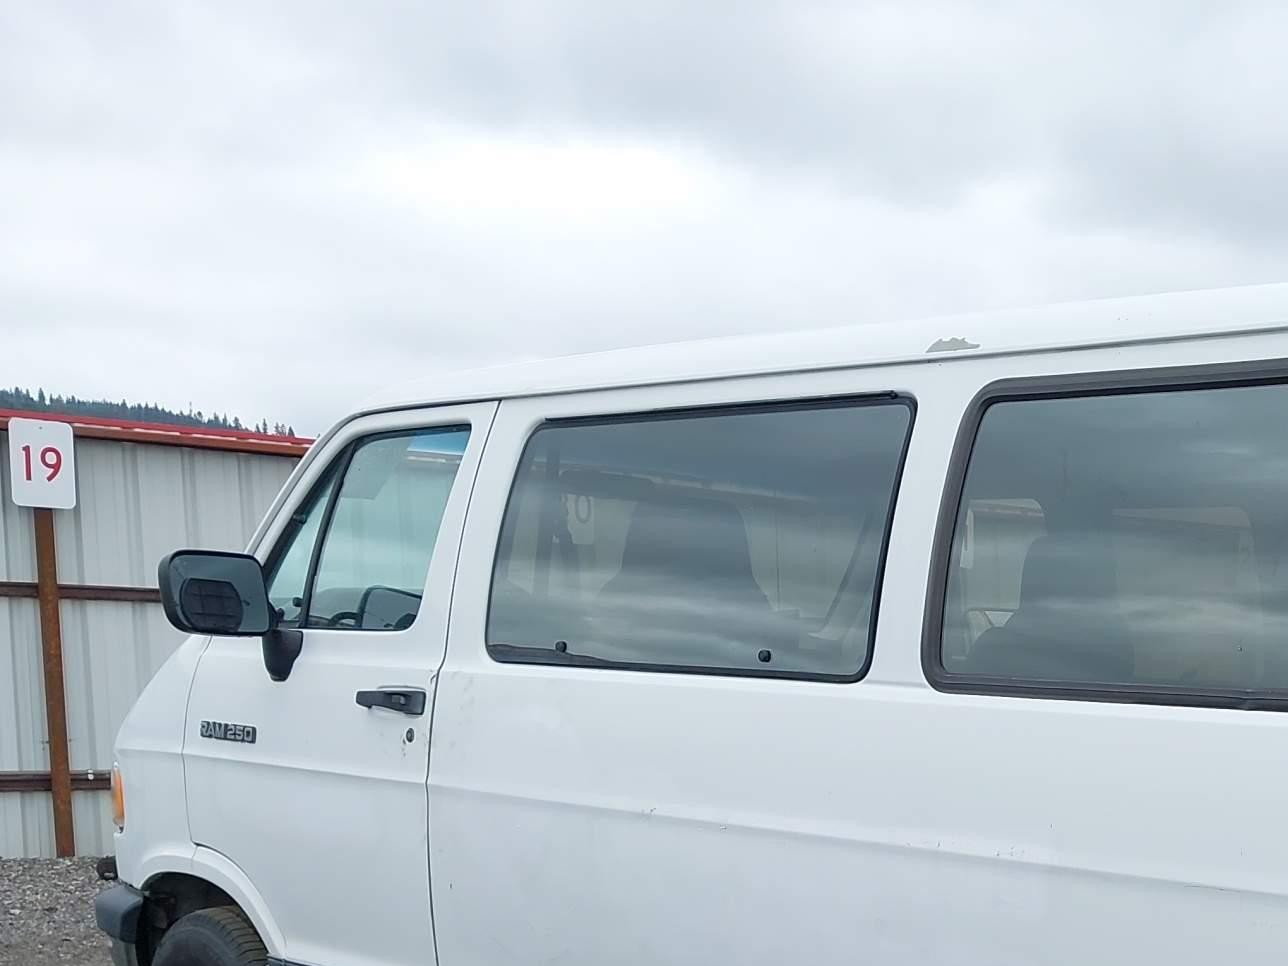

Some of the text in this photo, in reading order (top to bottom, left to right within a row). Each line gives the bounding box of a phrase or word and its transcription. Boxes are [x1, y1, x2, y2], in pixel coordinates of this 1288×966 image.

[21, 444, 63, 483] 19
[200, 720, 253, 742] RAM 250
